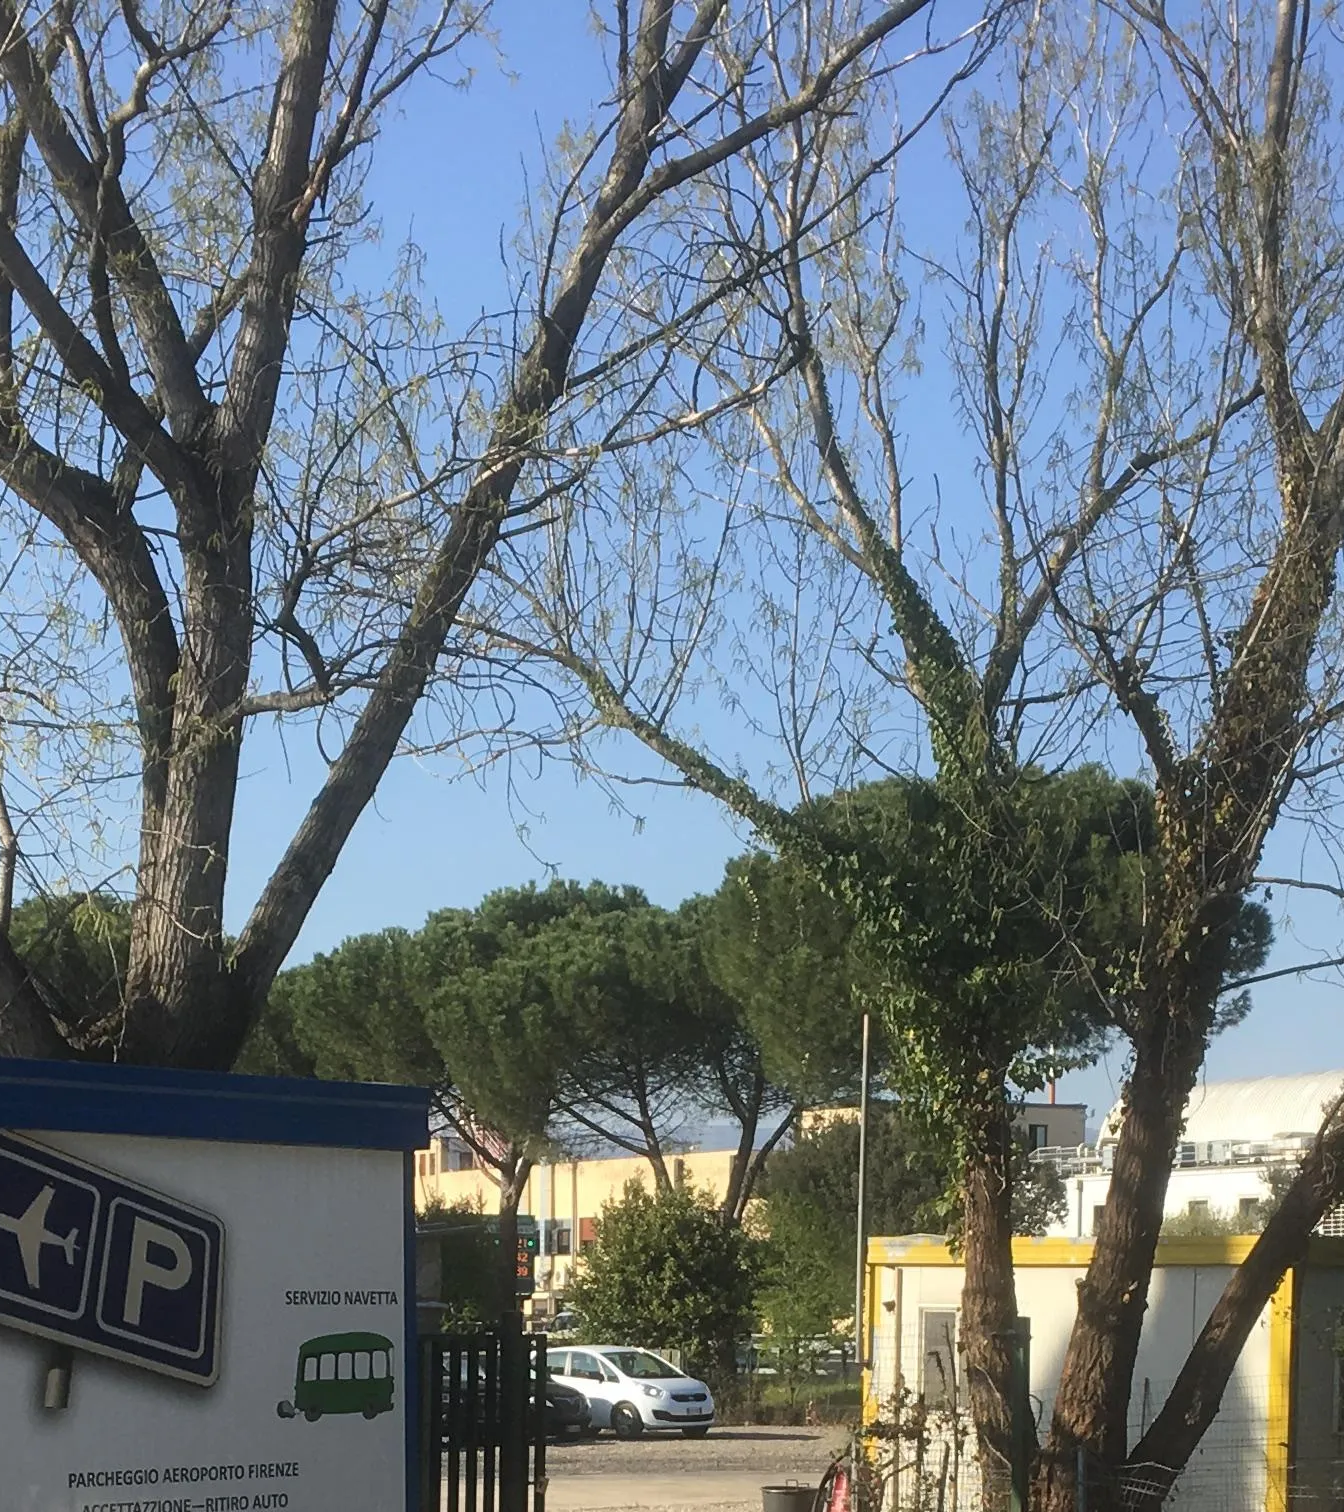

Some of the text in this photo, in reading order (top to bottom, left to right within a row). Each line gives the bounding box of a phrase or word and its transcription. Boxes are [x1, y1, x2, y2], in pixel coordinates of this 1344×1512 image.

[122, 1216, 193, 1325] P
[285, 1290, 398, 1306] SERVIZIO NAVETTA
[67, 1461, 300, 1489] PARCHEGGIO AEROPORTO FIRENZE
[252, 1492, 289, 1509] AUTO
